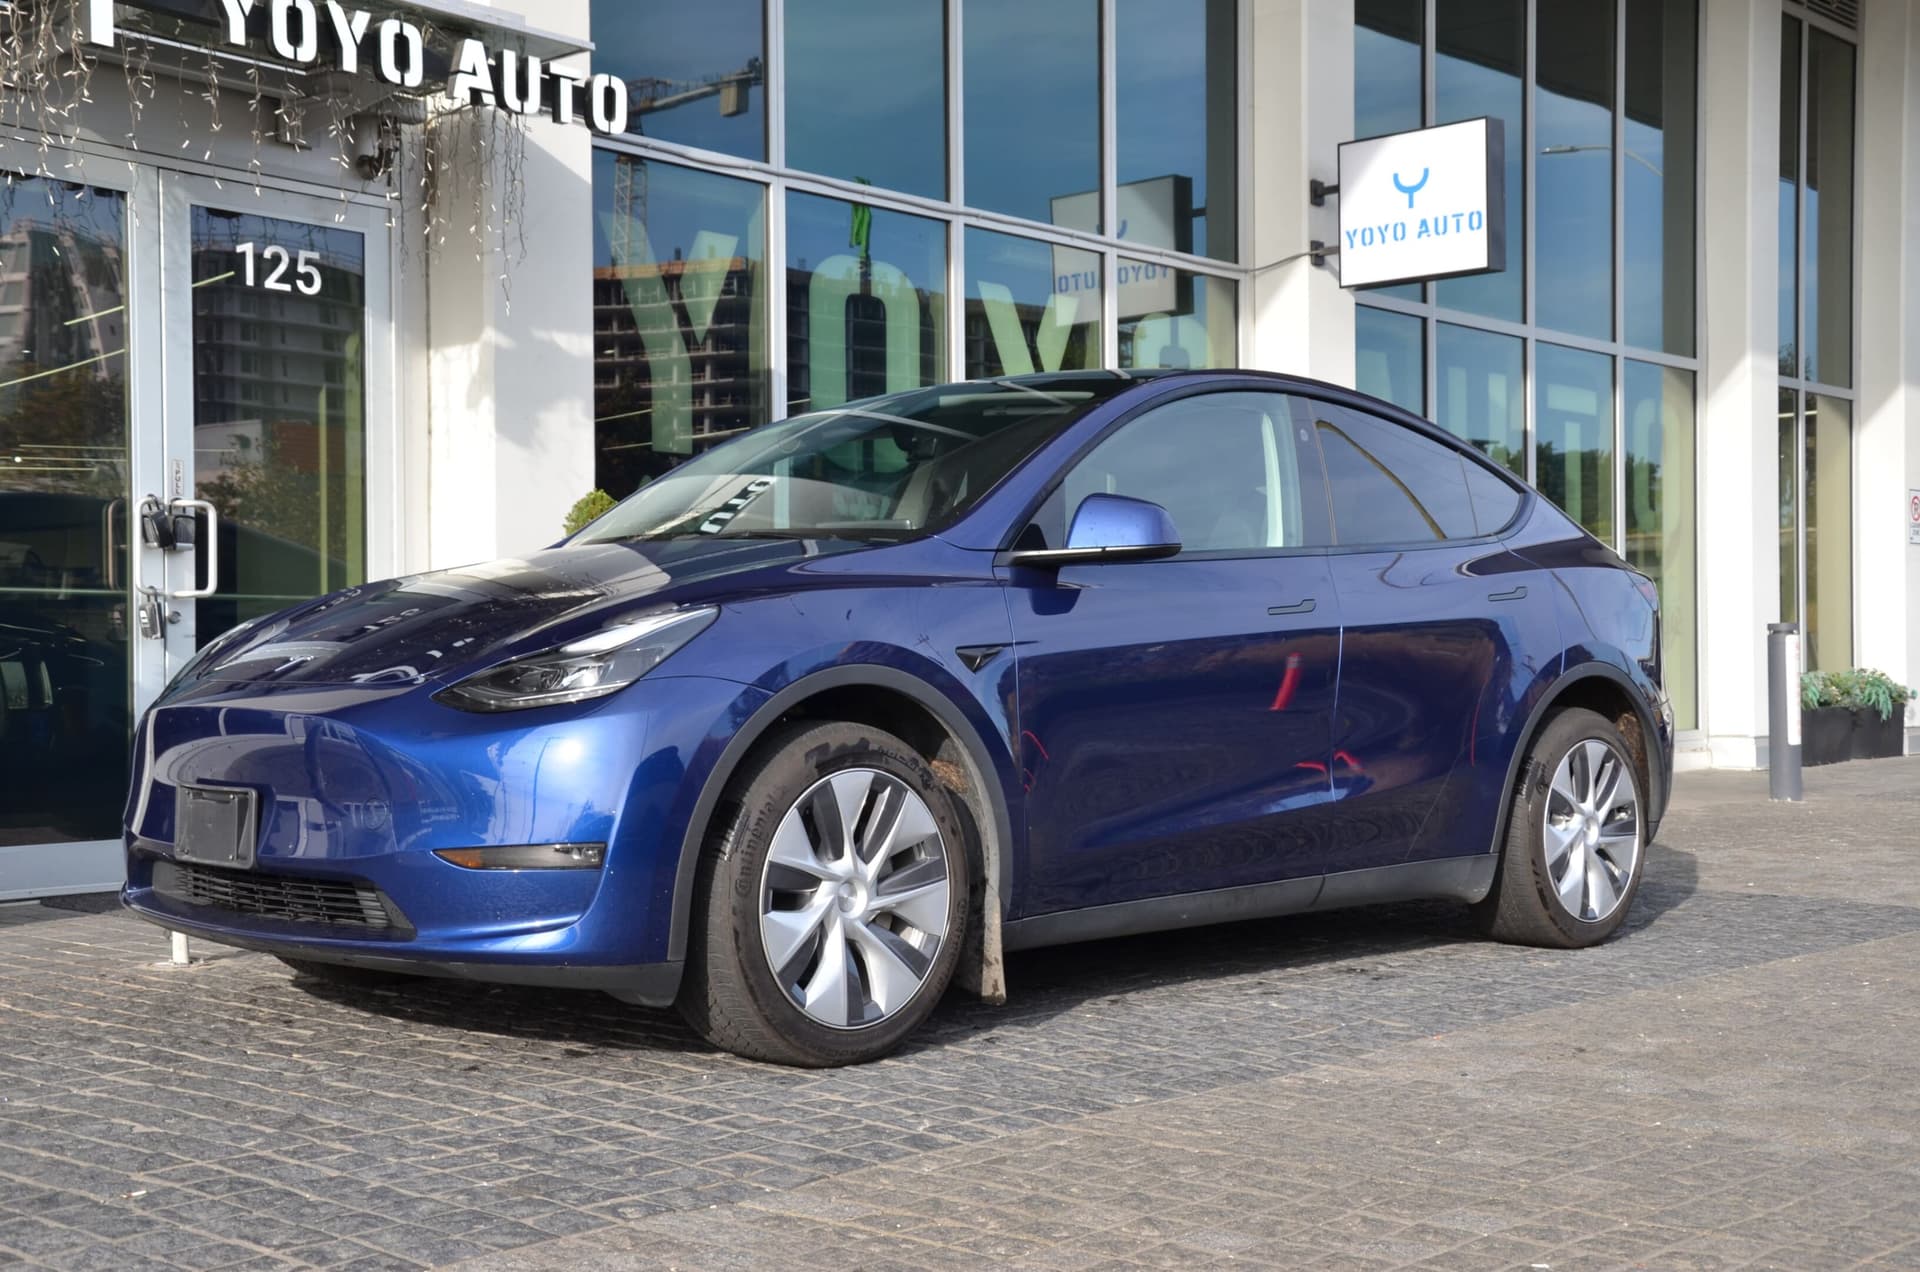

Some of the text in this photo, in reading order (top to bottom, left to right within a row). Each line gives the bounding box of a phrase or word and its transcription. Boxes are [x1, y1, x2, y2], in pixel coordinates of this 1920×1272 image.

[222, 0, 424, 88] YOYO
[452, 38, 628, 134] AUTO
[1345, 210, 1483, 249] YOYO AUTO
[235, 242, 322, 295] 125
